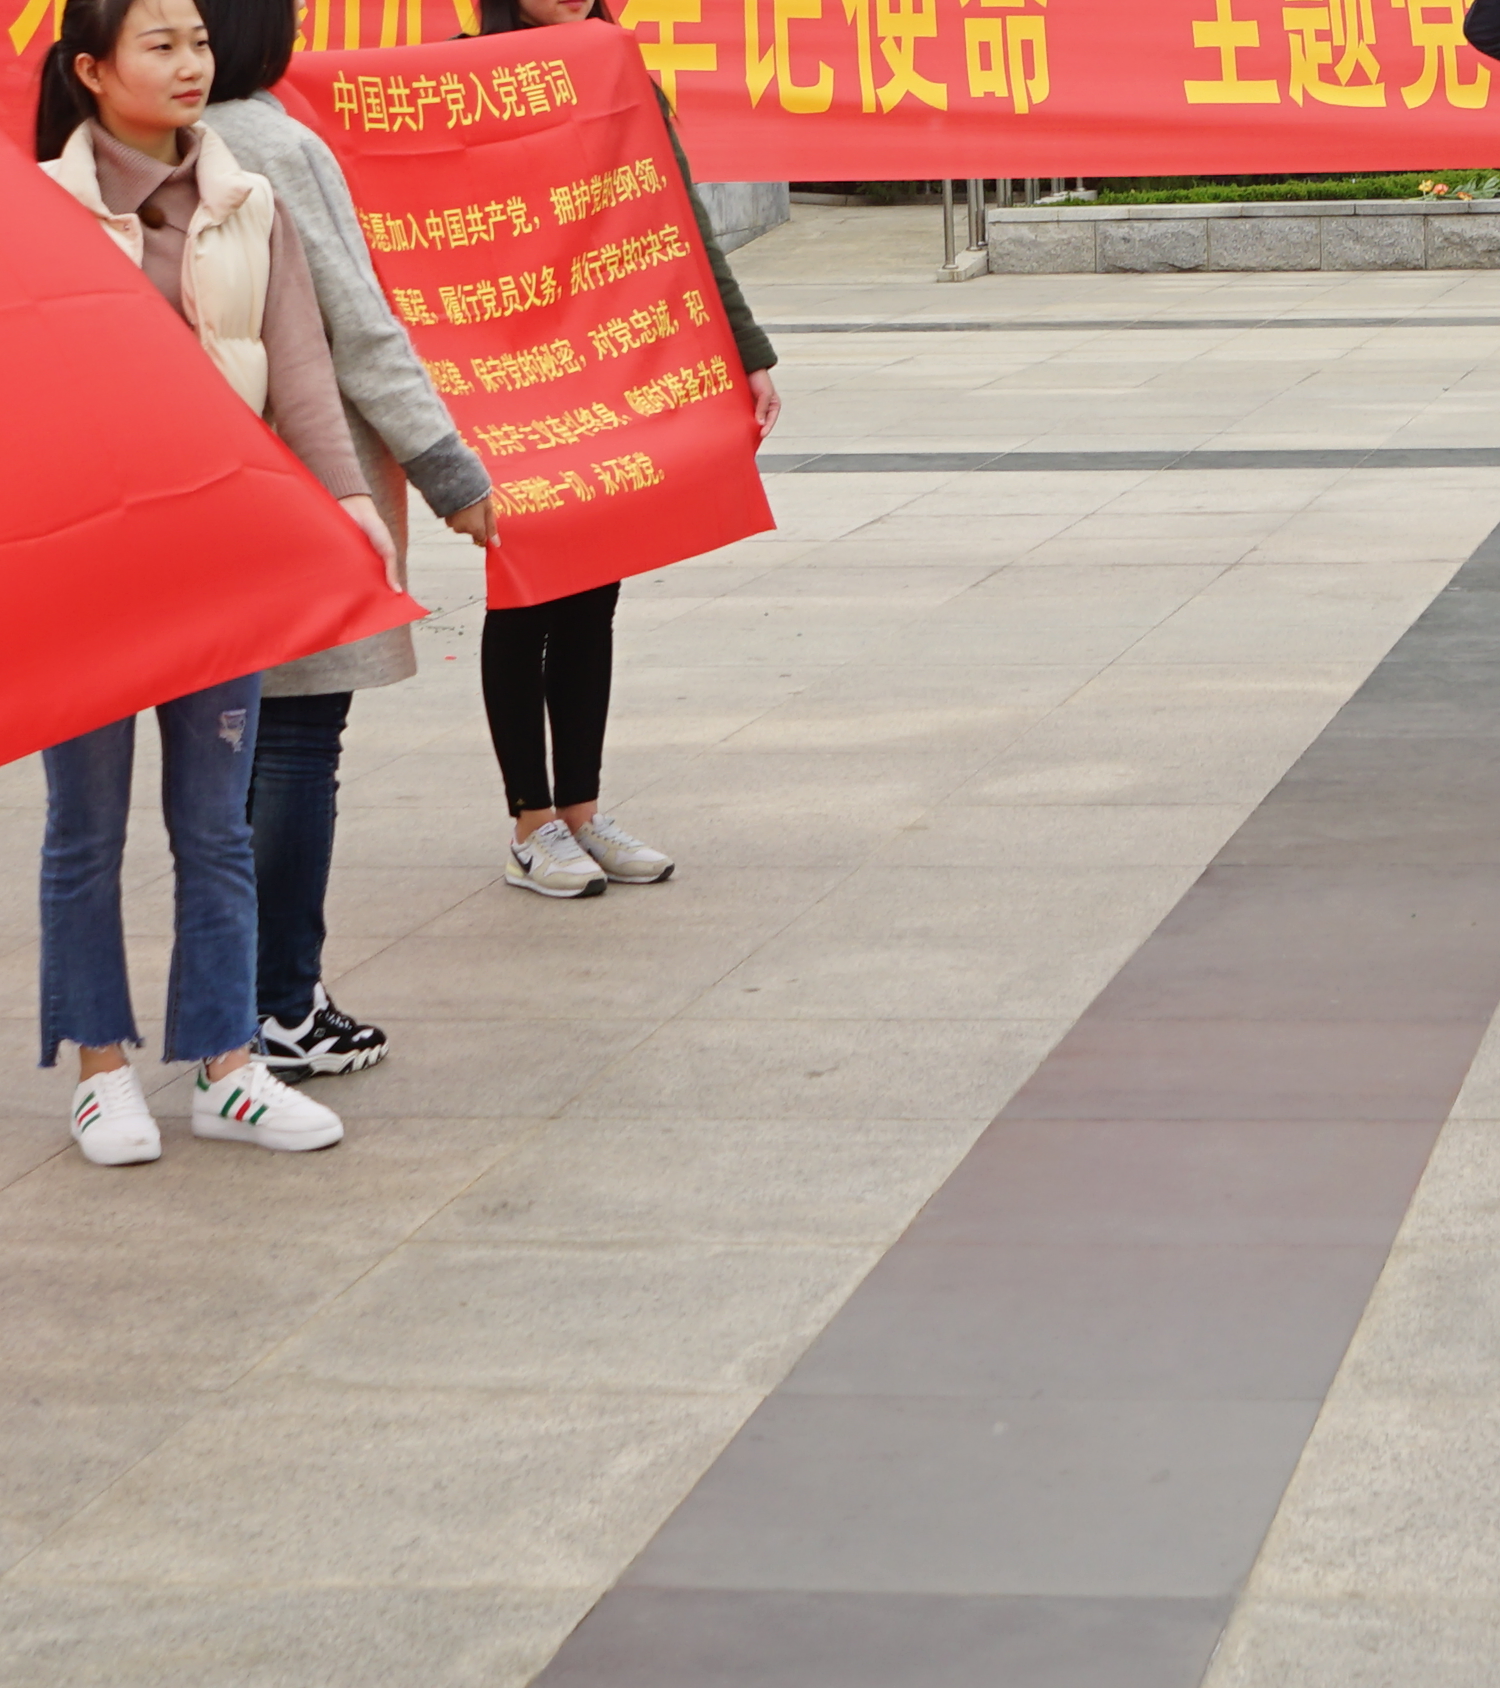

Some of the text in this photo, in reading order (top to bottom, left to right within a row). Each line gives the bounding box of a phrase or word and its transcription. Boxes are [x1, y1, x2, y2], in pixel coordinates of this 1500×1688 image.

[333, 59, 578, 132] 中国共产党入党誓词
